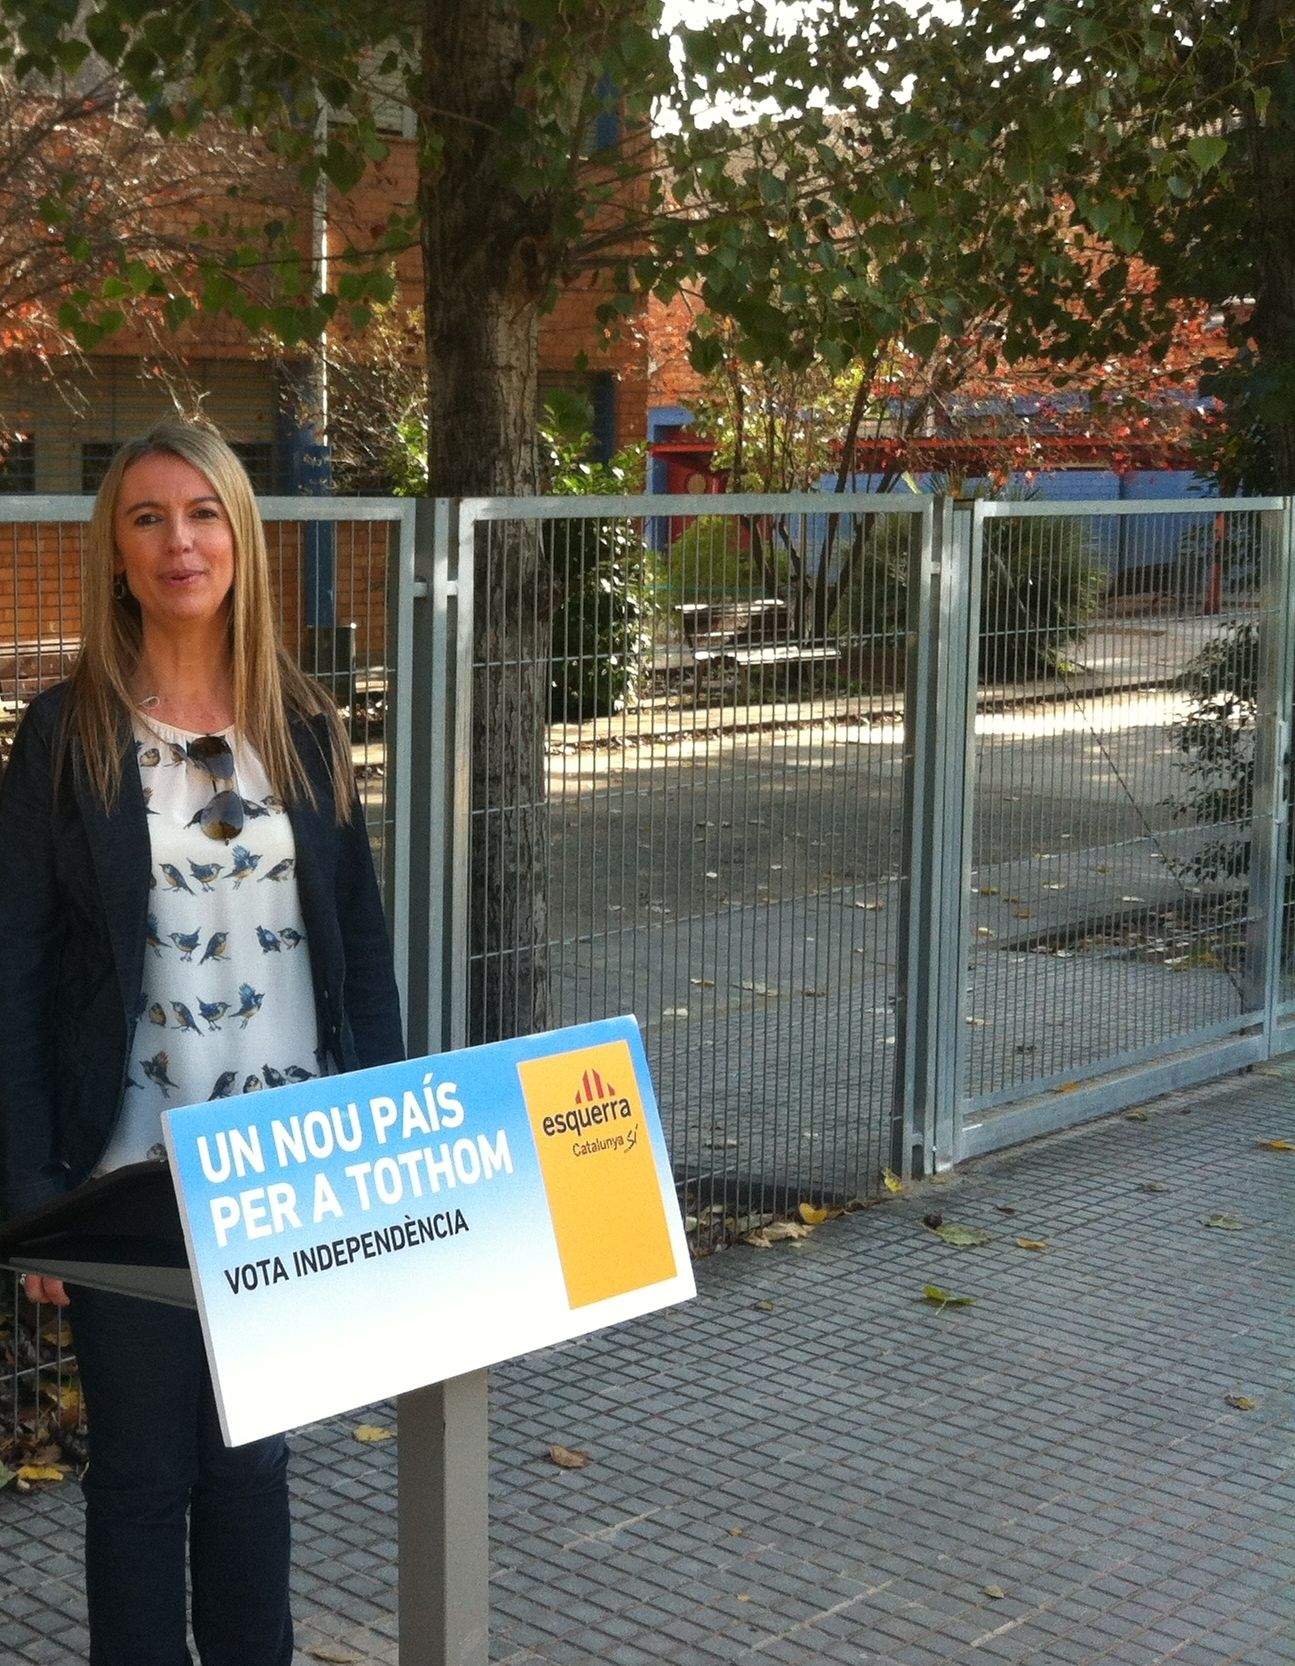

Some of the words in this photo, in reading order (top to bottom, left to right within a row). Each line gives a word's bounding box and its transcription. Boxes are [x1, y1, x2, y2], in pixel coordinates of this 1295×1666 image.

[196, 1124, 266, 1184] UN
[271, 1103, 363, 1168] NOU
[369, 1072, 465, 1144] PAÍS
[542, 1097, 632, 1137] esquerra
[572, 1134, 624, 1157] Catalunya
[209, 1182, 303, 1248] PER
[312, 1173, 344, 1223] A
[344, 1129, 514, 1211] TOTHOM
[224, 1256, 290, 1295] VOTA
[292, 1208, 470, 1277] INDEPENDÈNCIA
